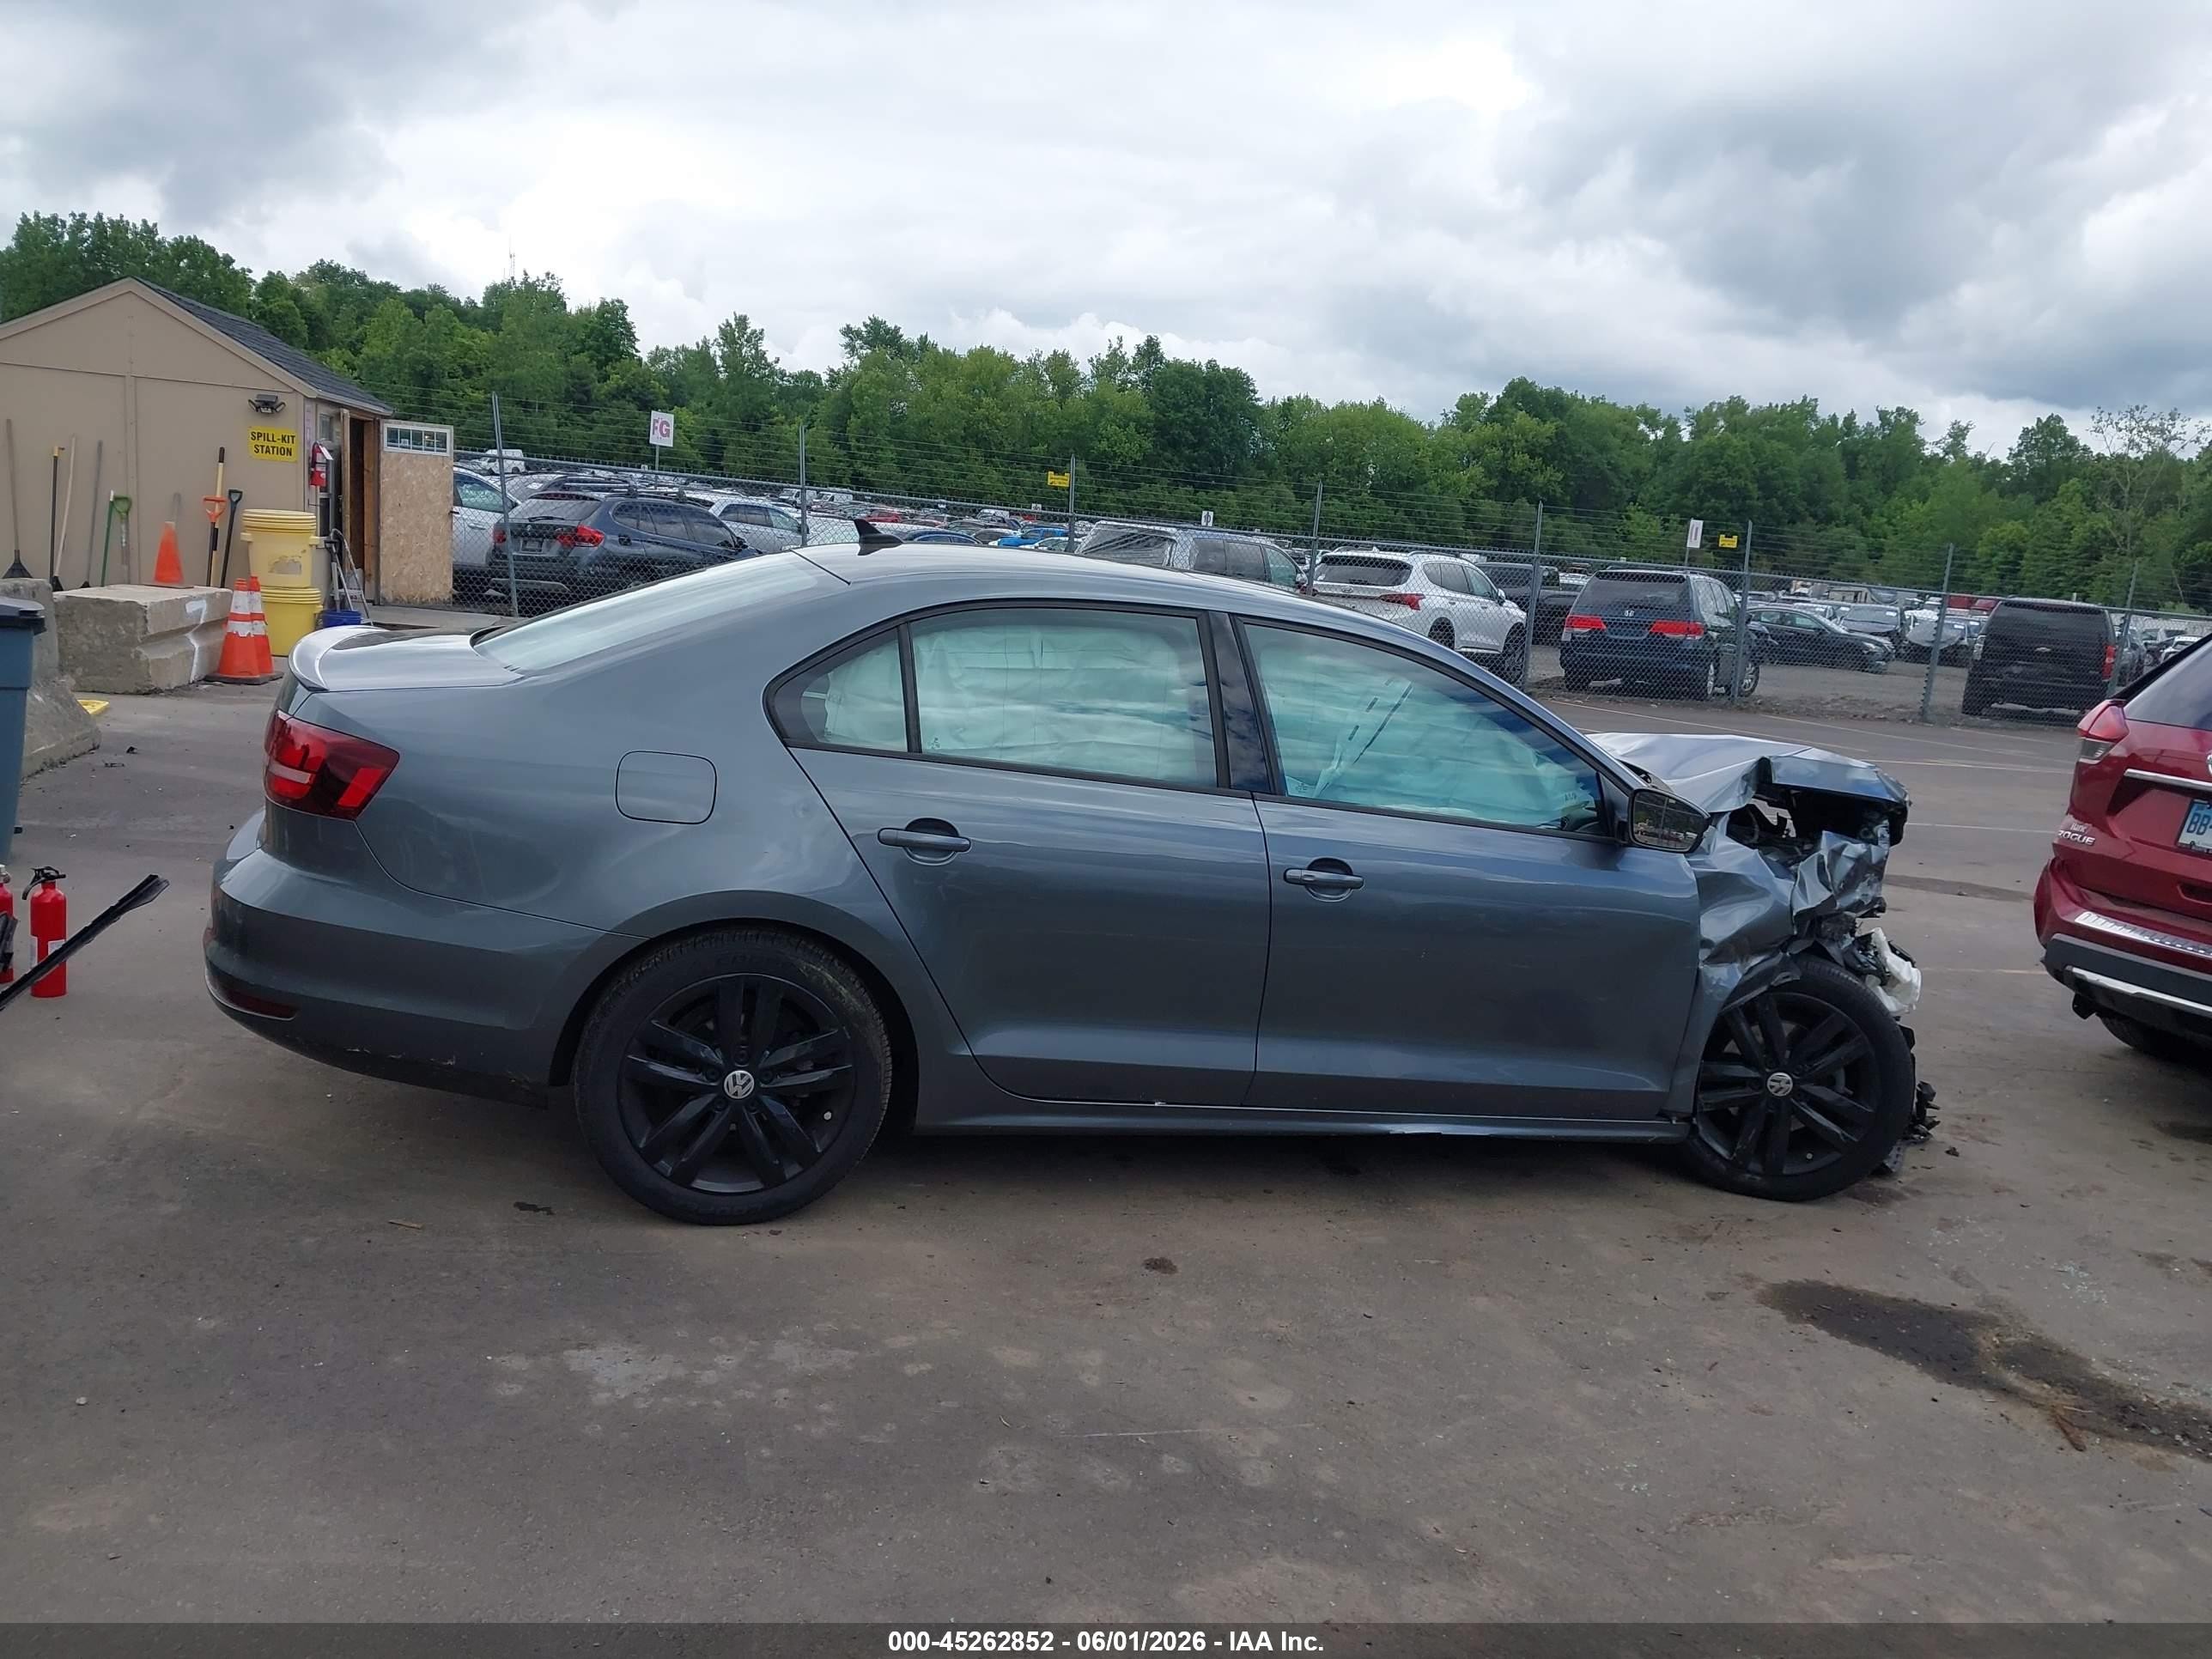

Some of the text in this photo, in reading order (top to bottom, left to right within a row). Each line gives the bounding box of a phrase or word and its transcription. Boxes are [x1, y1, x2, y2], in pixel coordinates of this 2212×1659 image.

[653, 418, 671, 438] FG
[250, 431, 296, 444] SPILL-KIT
[253, 444, 293, 457] STATION
